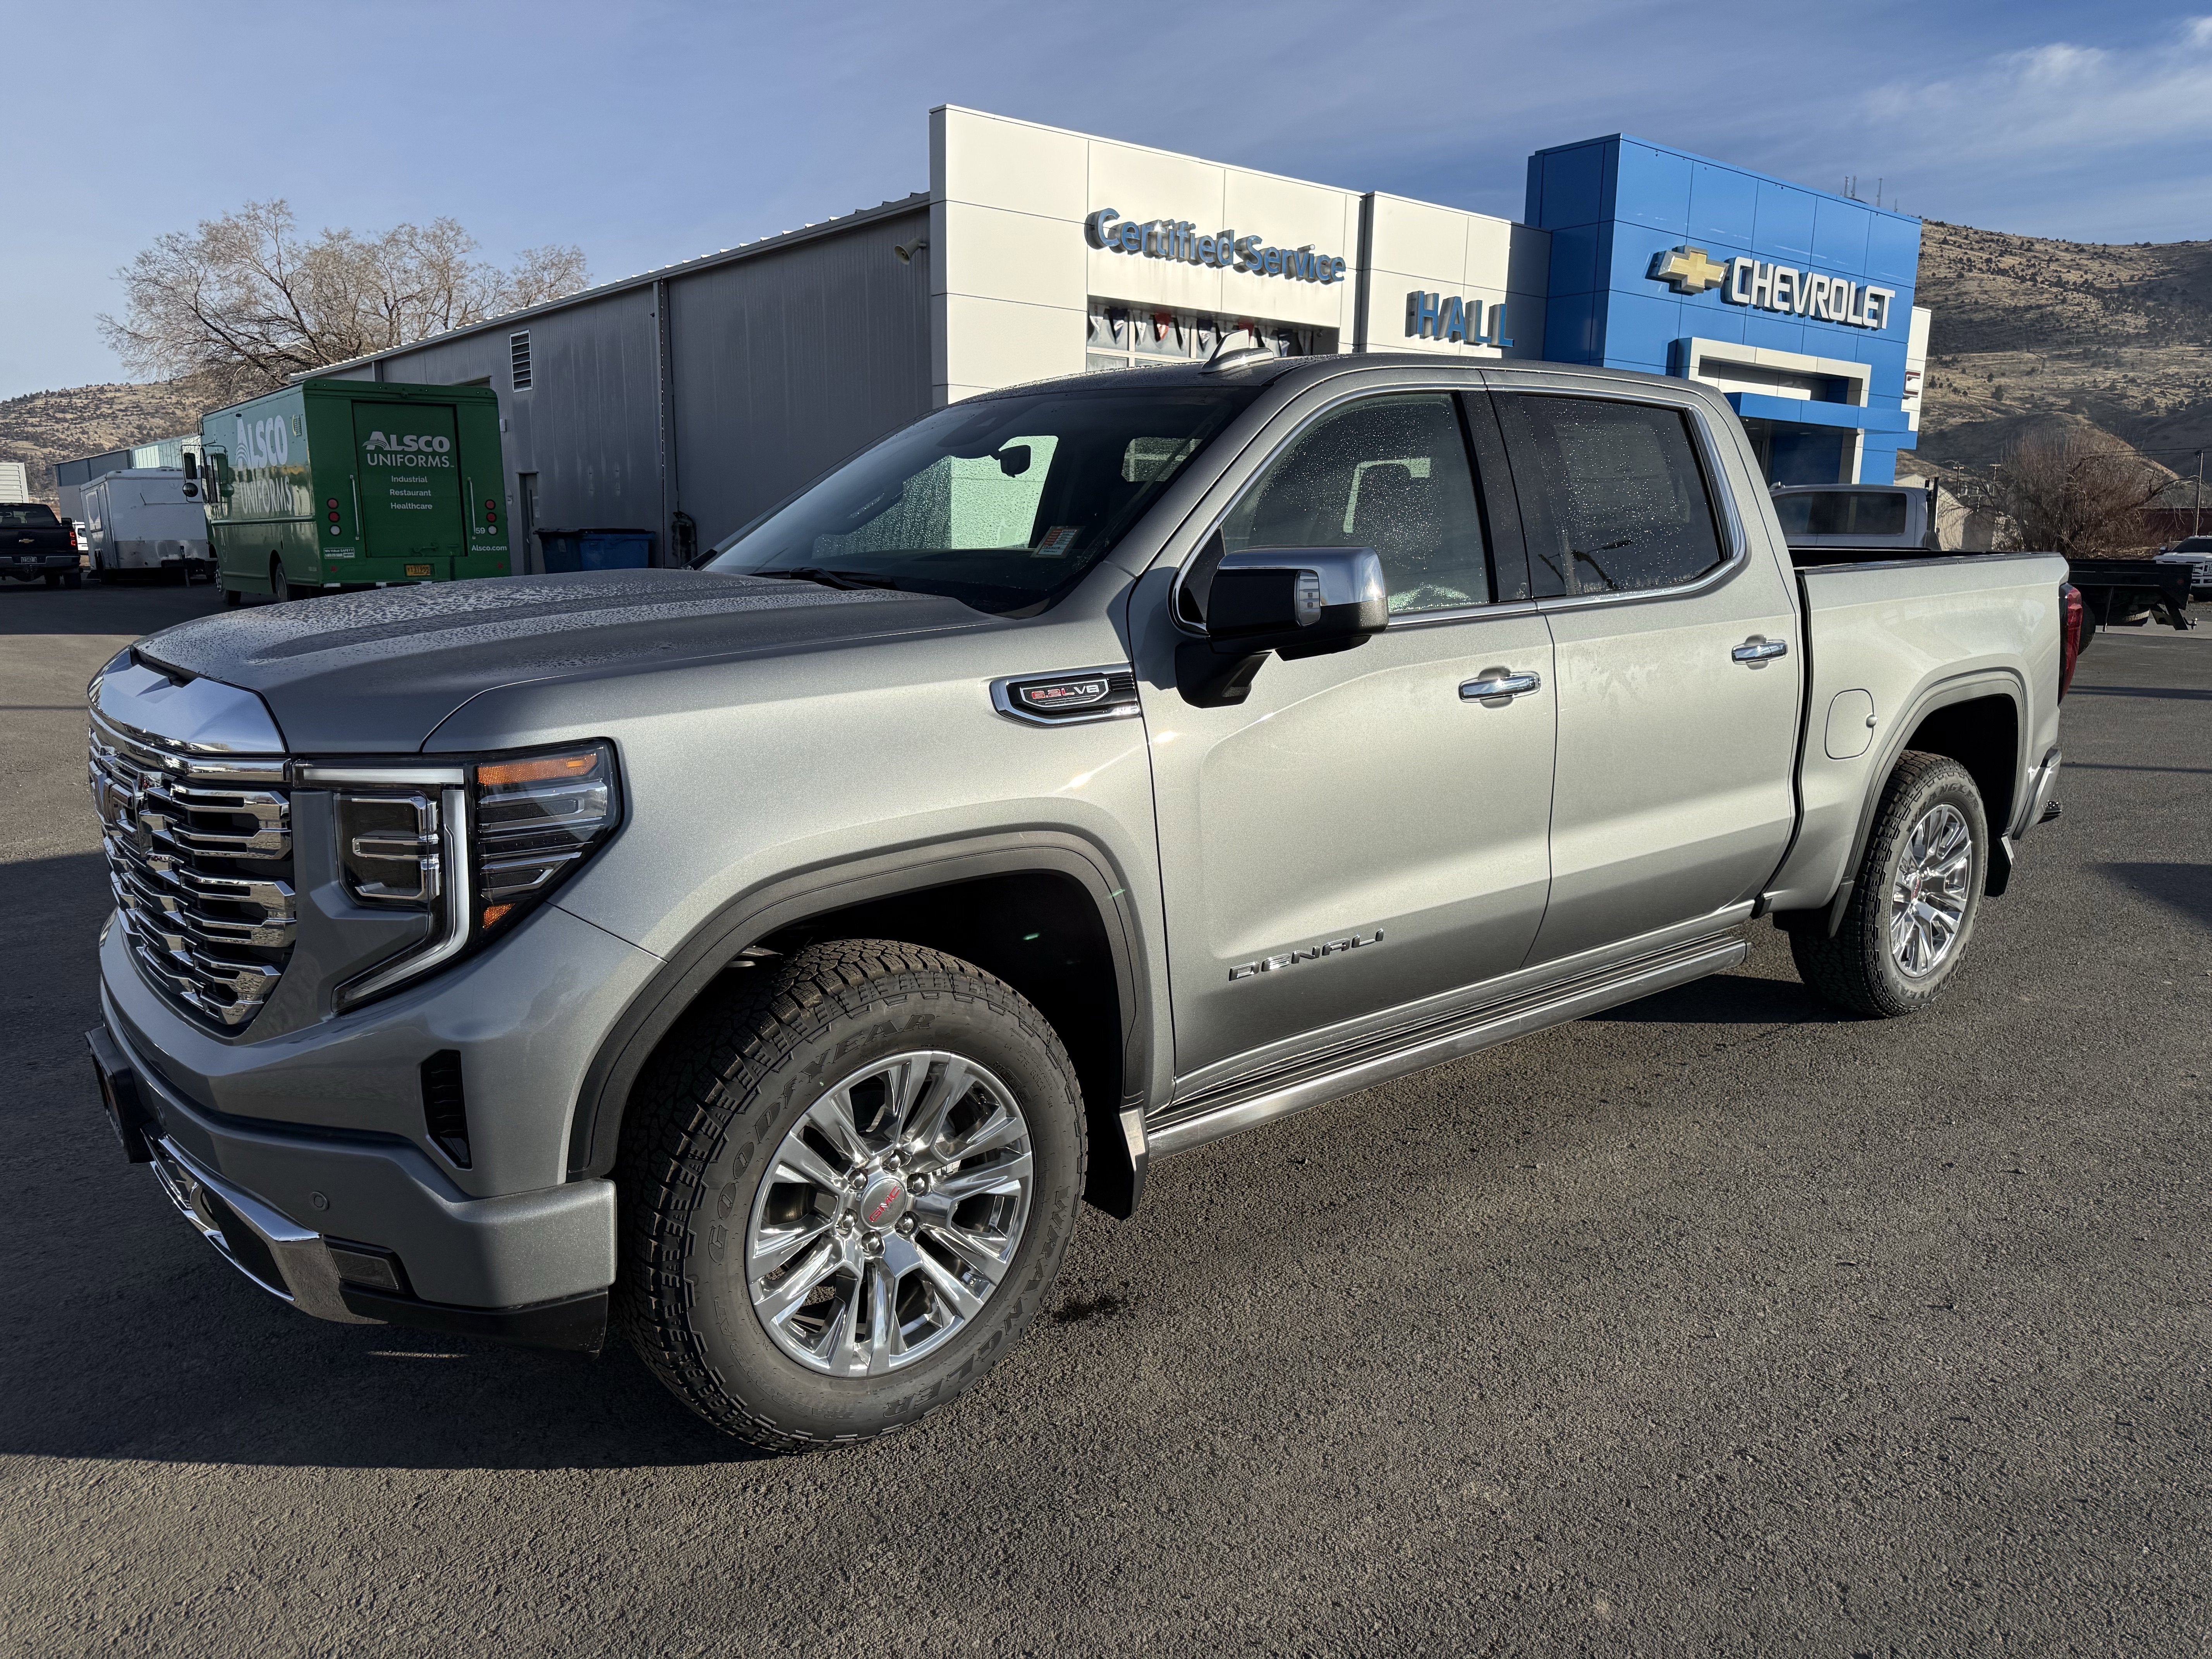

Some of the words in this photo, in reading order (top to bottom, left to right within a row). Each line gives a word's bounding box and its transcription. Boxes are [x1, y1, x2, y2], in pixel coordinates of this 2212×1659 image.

[1095, 208, 1235, 266] Certified
[1244, 235, 1345, 282] Service
[1415, 290, 1514, 347] HALL
[1732, 256, 1895, 329] CHEVROLET
[236, 415, 288, 471] ALSCO
[362, 431, 450, 453] ALSCO
[367, 453, 450, 467] UNIFORMS
[240, 476, 293, 514] UNIFORMS
[1031, 688, 1075, 699] 6.2L
[1073, 684, 1100, 695] V8
[1228, 928, 1384, 981] DENALI
[708, 1012, 936, 1264] GOODYEAR
[869, 1184, 901, 1223] GMC
[883, 1185, 1070, 1418] WRANGLER
